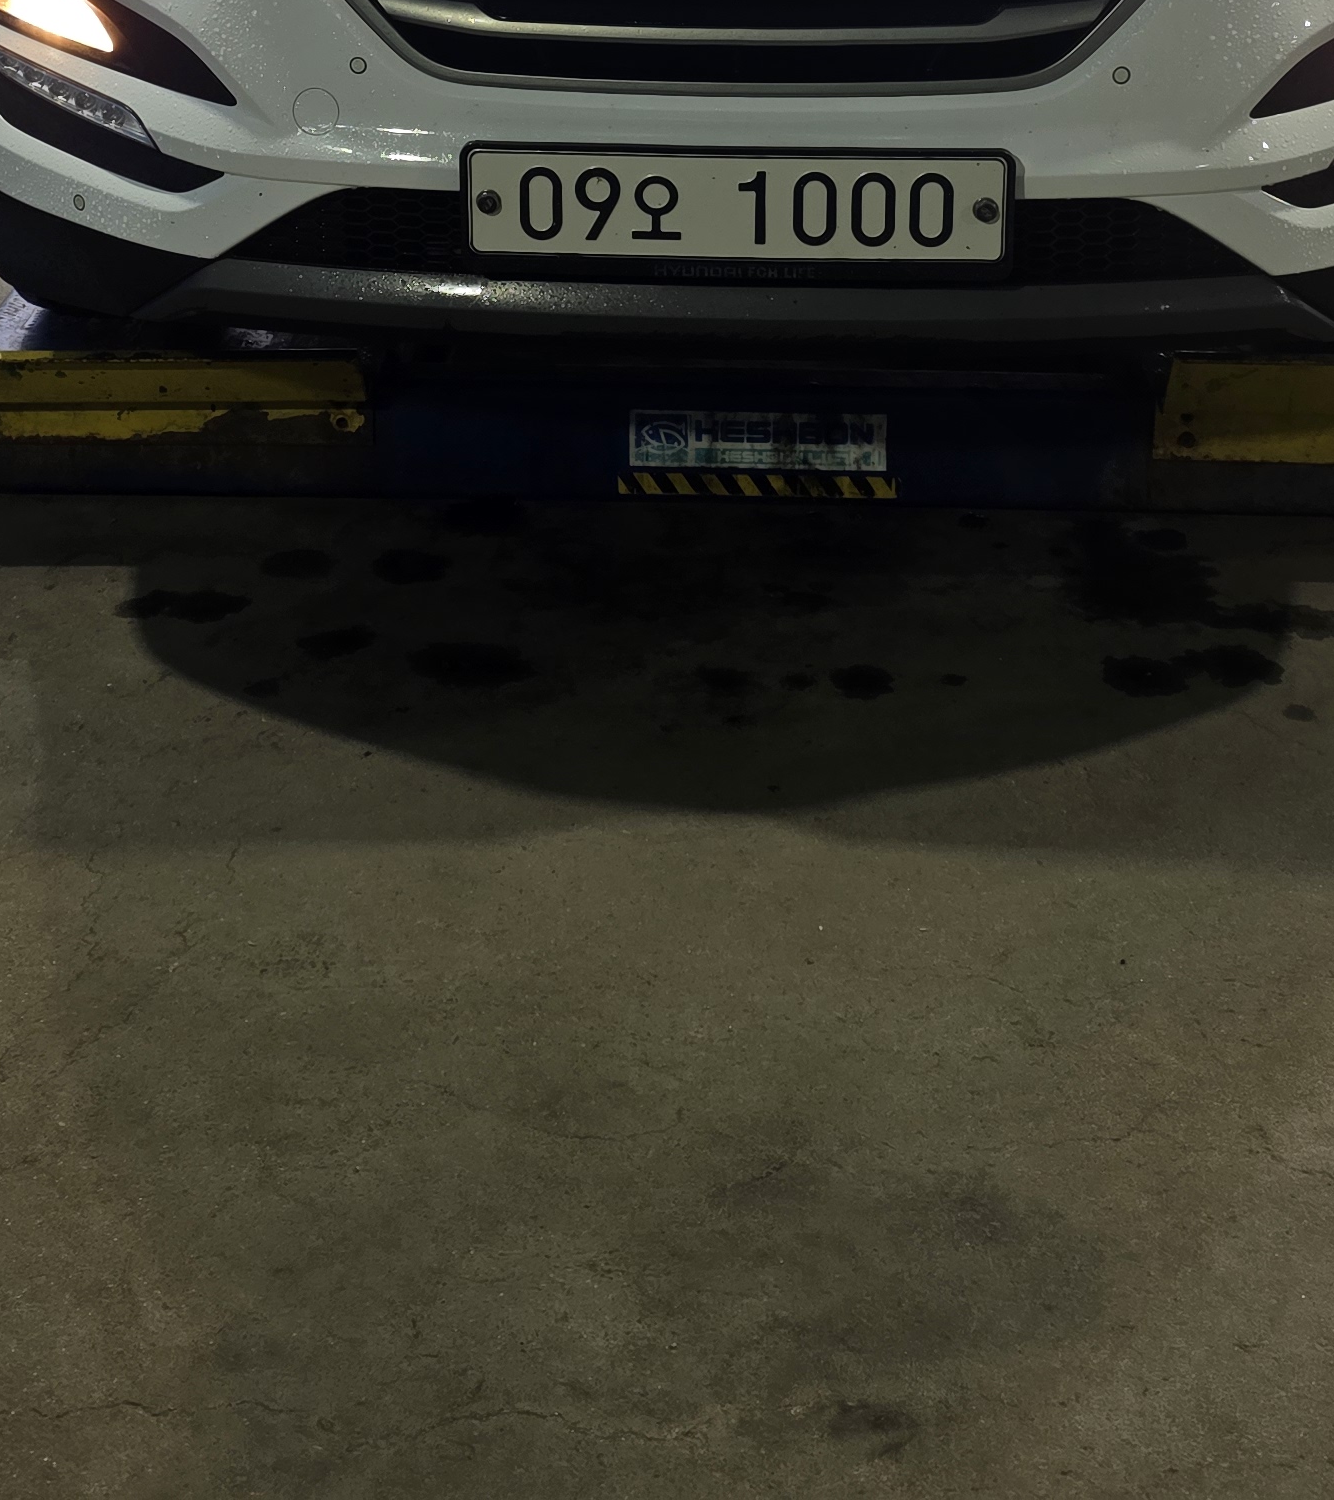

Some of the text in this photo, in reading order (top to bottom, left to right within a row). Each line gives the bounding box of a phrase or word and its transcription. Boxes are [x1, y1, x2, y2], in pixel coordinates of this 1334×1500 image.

[518, 166, 955, 248] 09오 1000
[654, 264, 741, 277] HYUNDAI
[694, 419, 875, 445] HESHBON
